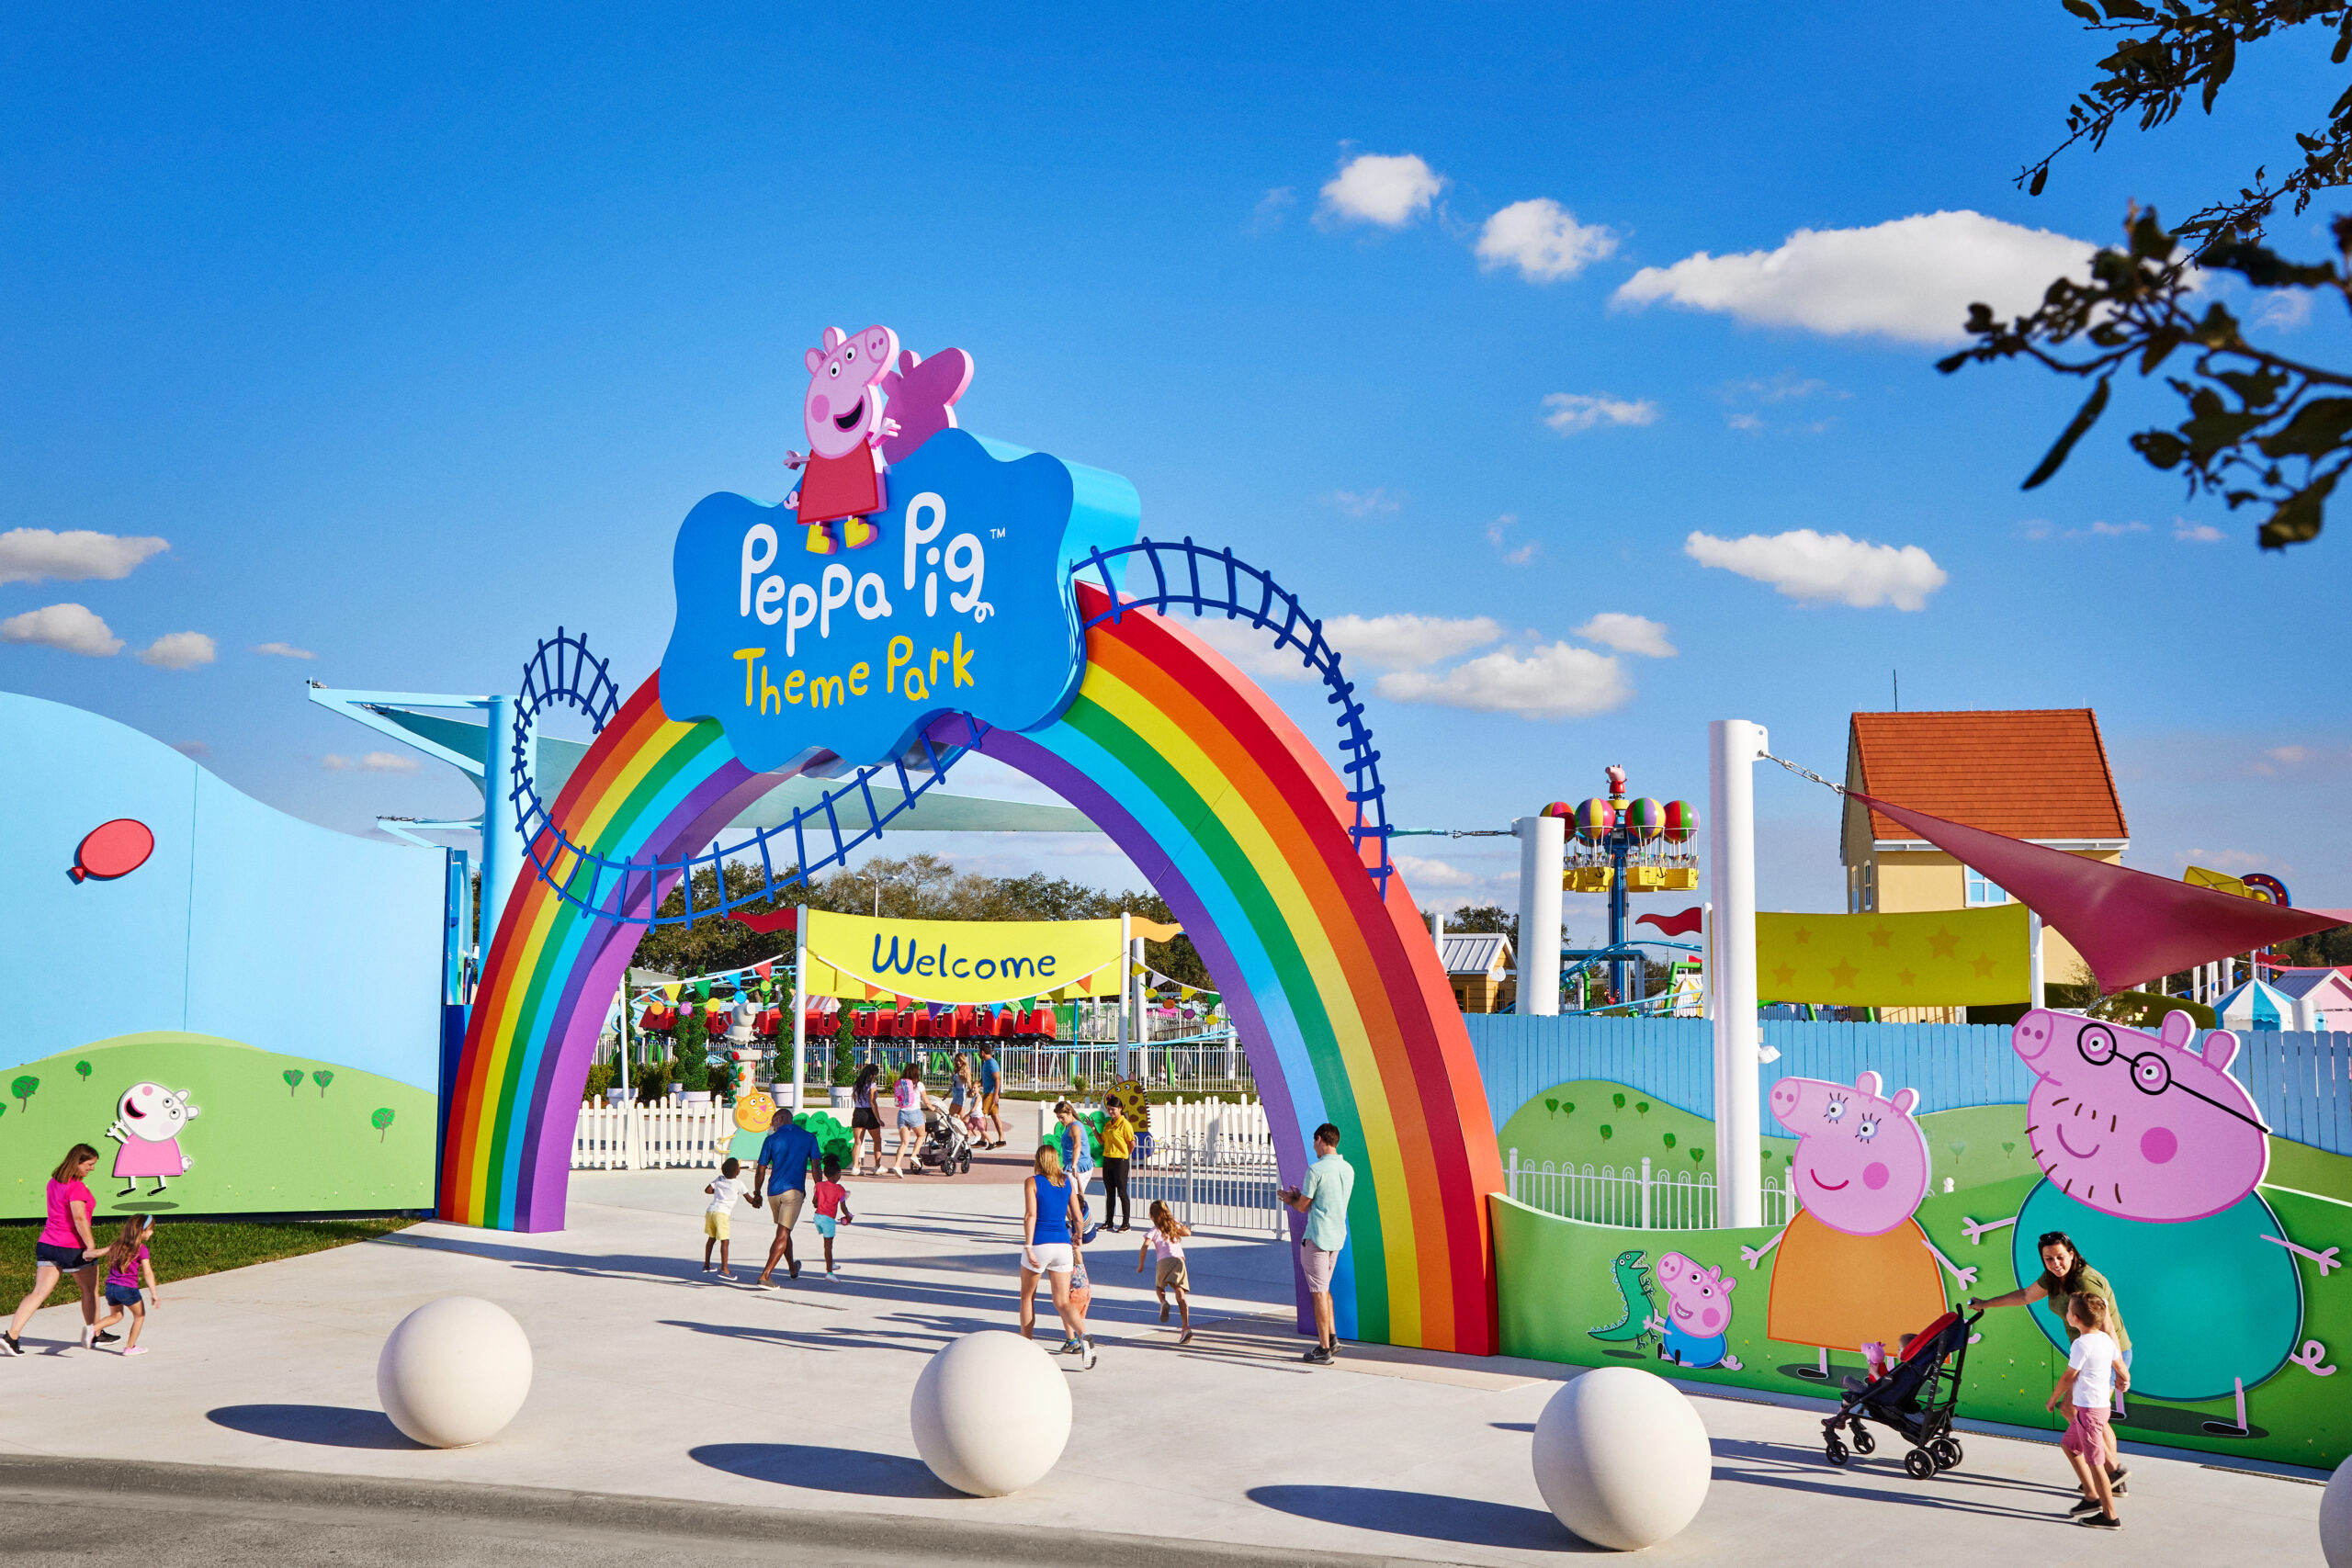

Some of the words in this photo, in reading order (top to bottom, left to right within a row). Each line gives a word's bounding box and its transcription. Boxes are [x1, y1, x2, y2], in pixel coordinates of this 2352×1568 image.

[740, 523, 893, 658] Peppa
[903, 491, 995, 624] Pig
[732, 648, 869, 716] Theme
[887, 631, 975, 702] Park
[872, 933, 1057, 980] Welcome
